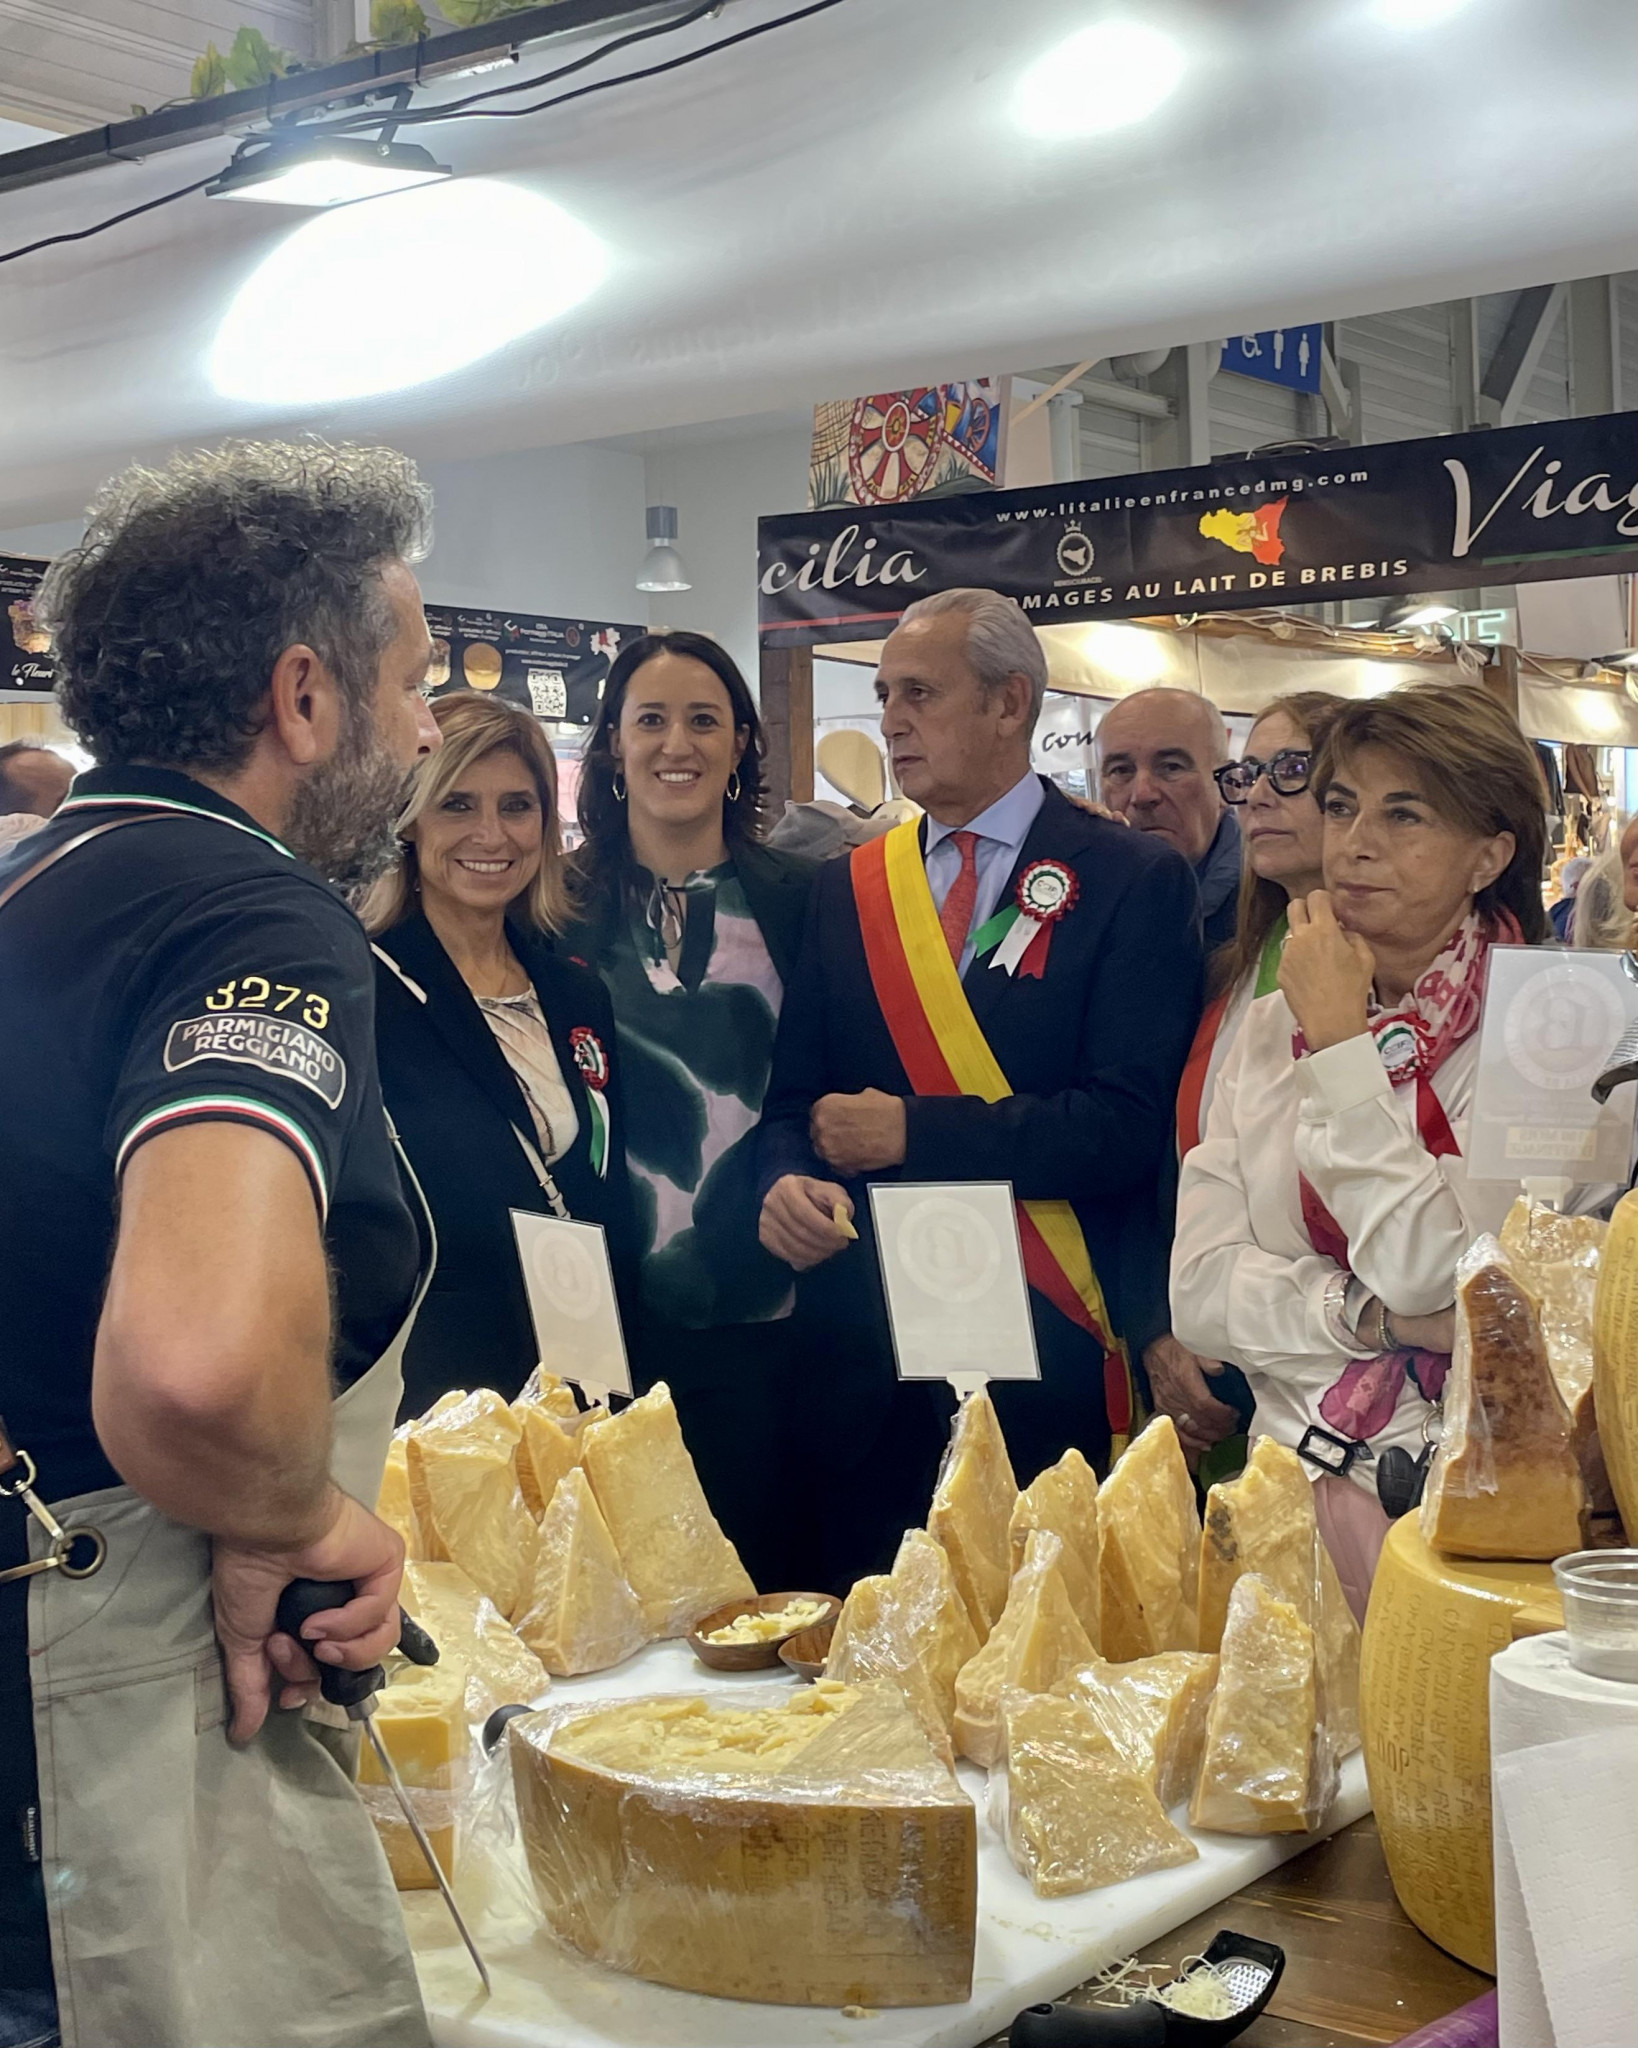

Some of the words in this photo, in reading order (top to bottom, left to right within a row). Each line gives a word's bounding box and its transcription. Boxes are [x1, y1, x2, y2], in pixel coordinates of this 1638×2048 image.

[757, 524, 928, 595] cilia
[1125, 583, 1161, 601] AU
[1174, 575, 1236, 596] LAIT
[1249, 570, 1286, 589] DE
[1300, 559, 1408, 585] BREBIS
[205, 976, 330, 1030] 3273
[182, 1018, 336, 1073] PARMIGIANO
[194, 1033, 321, 1082] REGGIANO
